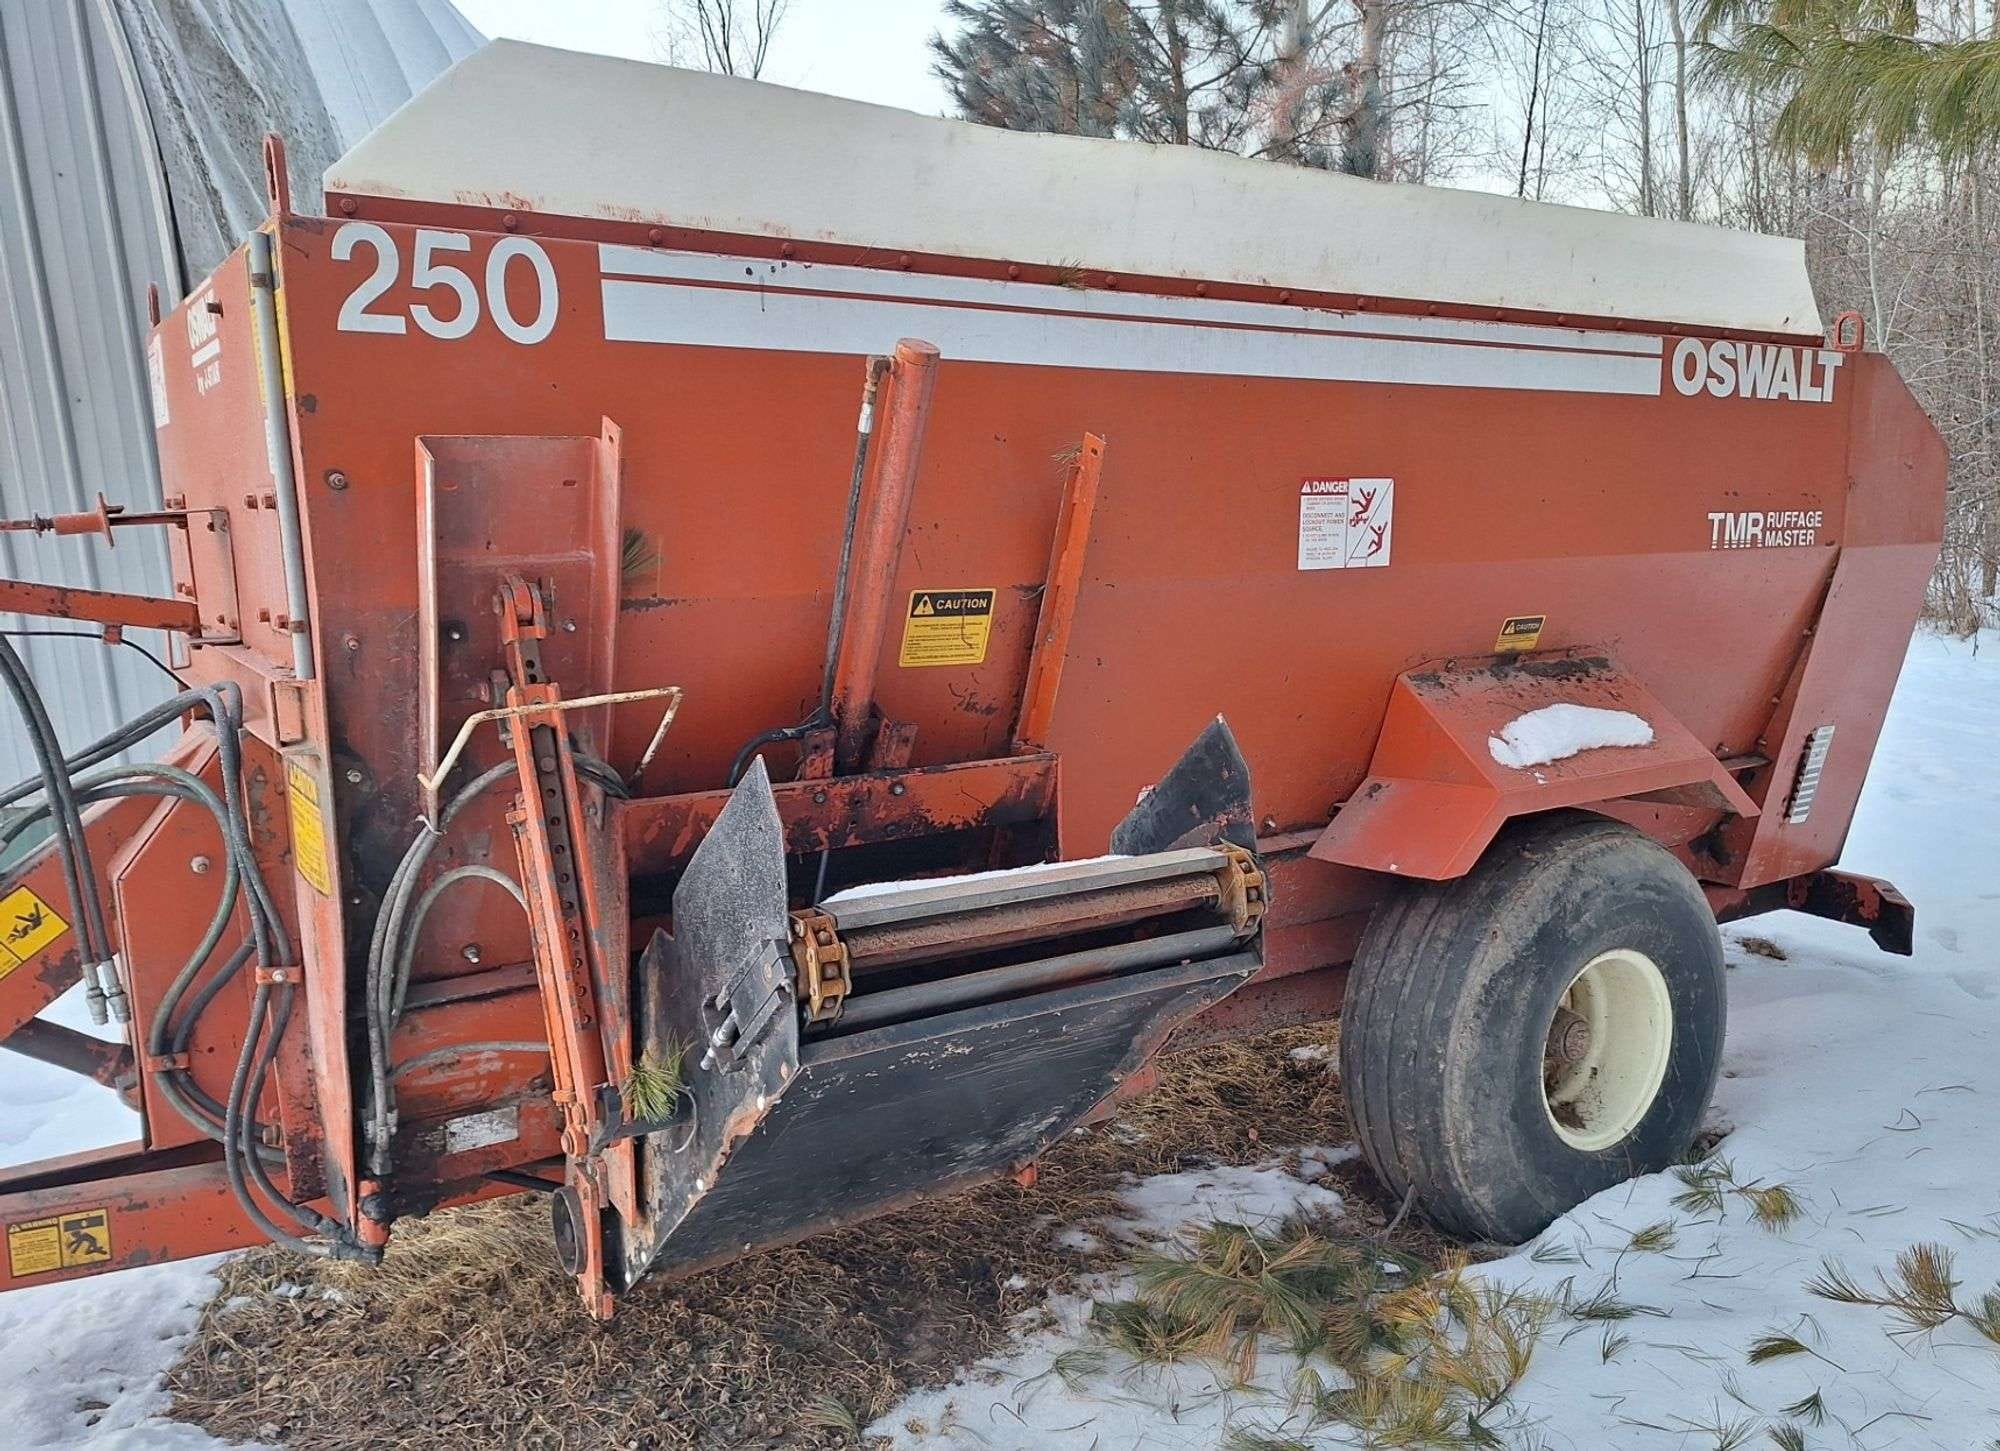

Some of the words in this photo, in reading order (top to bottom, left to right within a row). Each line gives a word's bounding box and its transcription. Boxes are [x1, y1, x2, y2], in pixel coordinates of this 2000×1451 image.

[330, 221, 560, 345] 250
[1671, 336, 1845, 403] OSWALT
[1312, 481, 1348, 493] DANGER
[1766, 511, 1823, 528] RUFFAGE
[1707, 511, 1764, 549] TMR
[1764, 529, 1815, 548] MASTER
[936, 598, 988, 610] CAUTION
